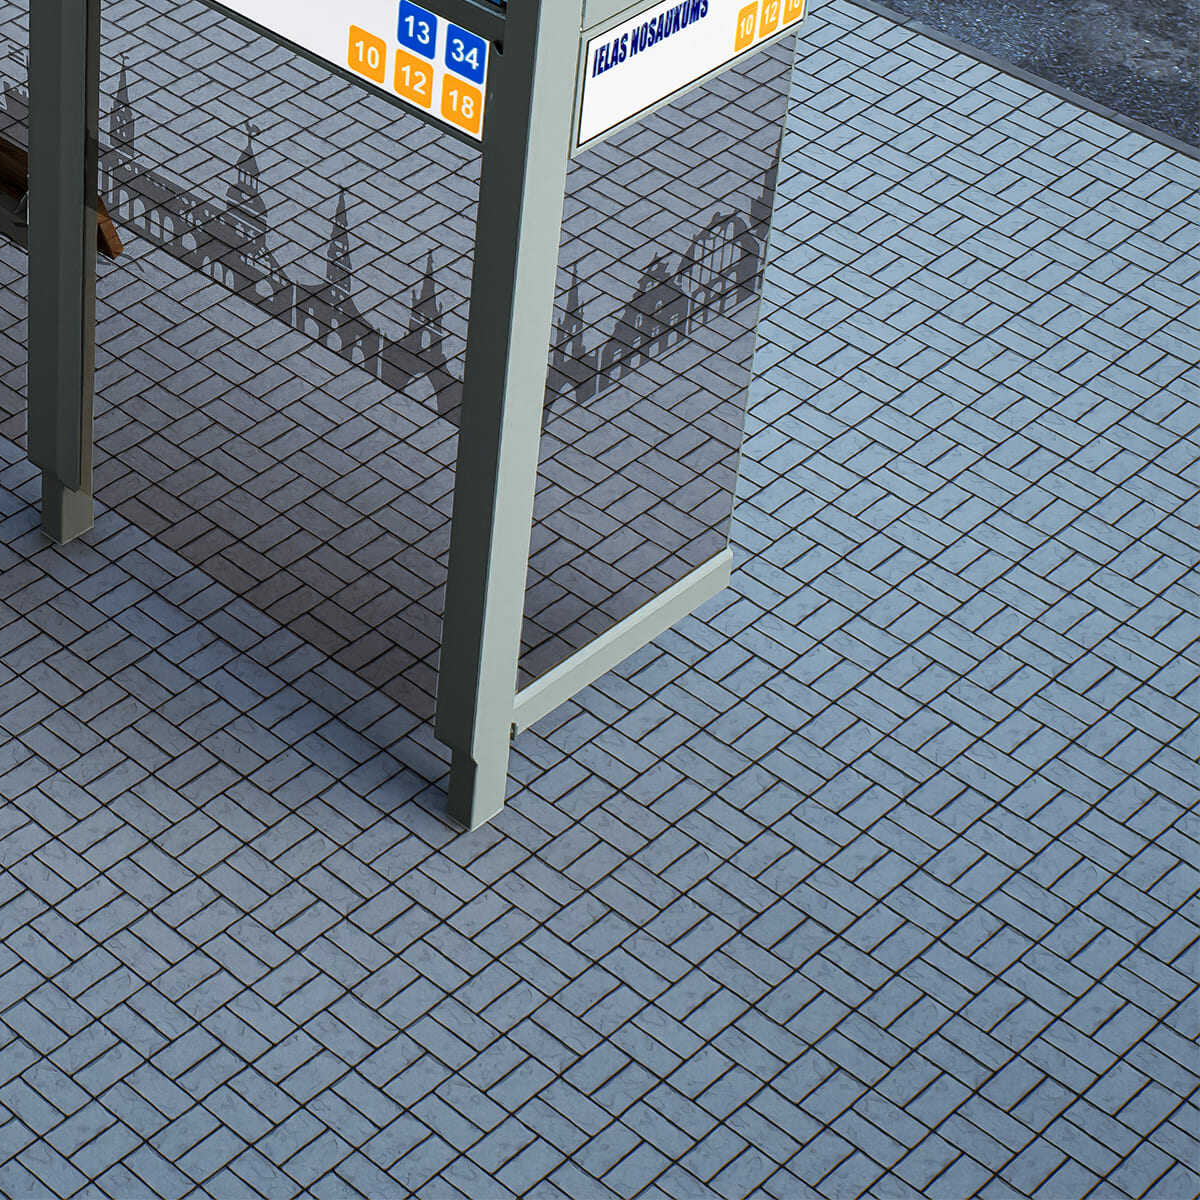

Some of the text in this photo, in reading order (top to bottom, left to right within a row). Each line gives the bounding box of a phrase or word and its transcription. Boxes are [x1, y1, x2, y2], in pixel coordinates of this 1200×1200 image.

[404, 14, 480, 70] 13 34
[740, 17, 754, 39] 10
[764, 3, 778, 24] 12
[355, 38, 474, 120] 10 12 18
[592, 34, 627, 78] IELAS
